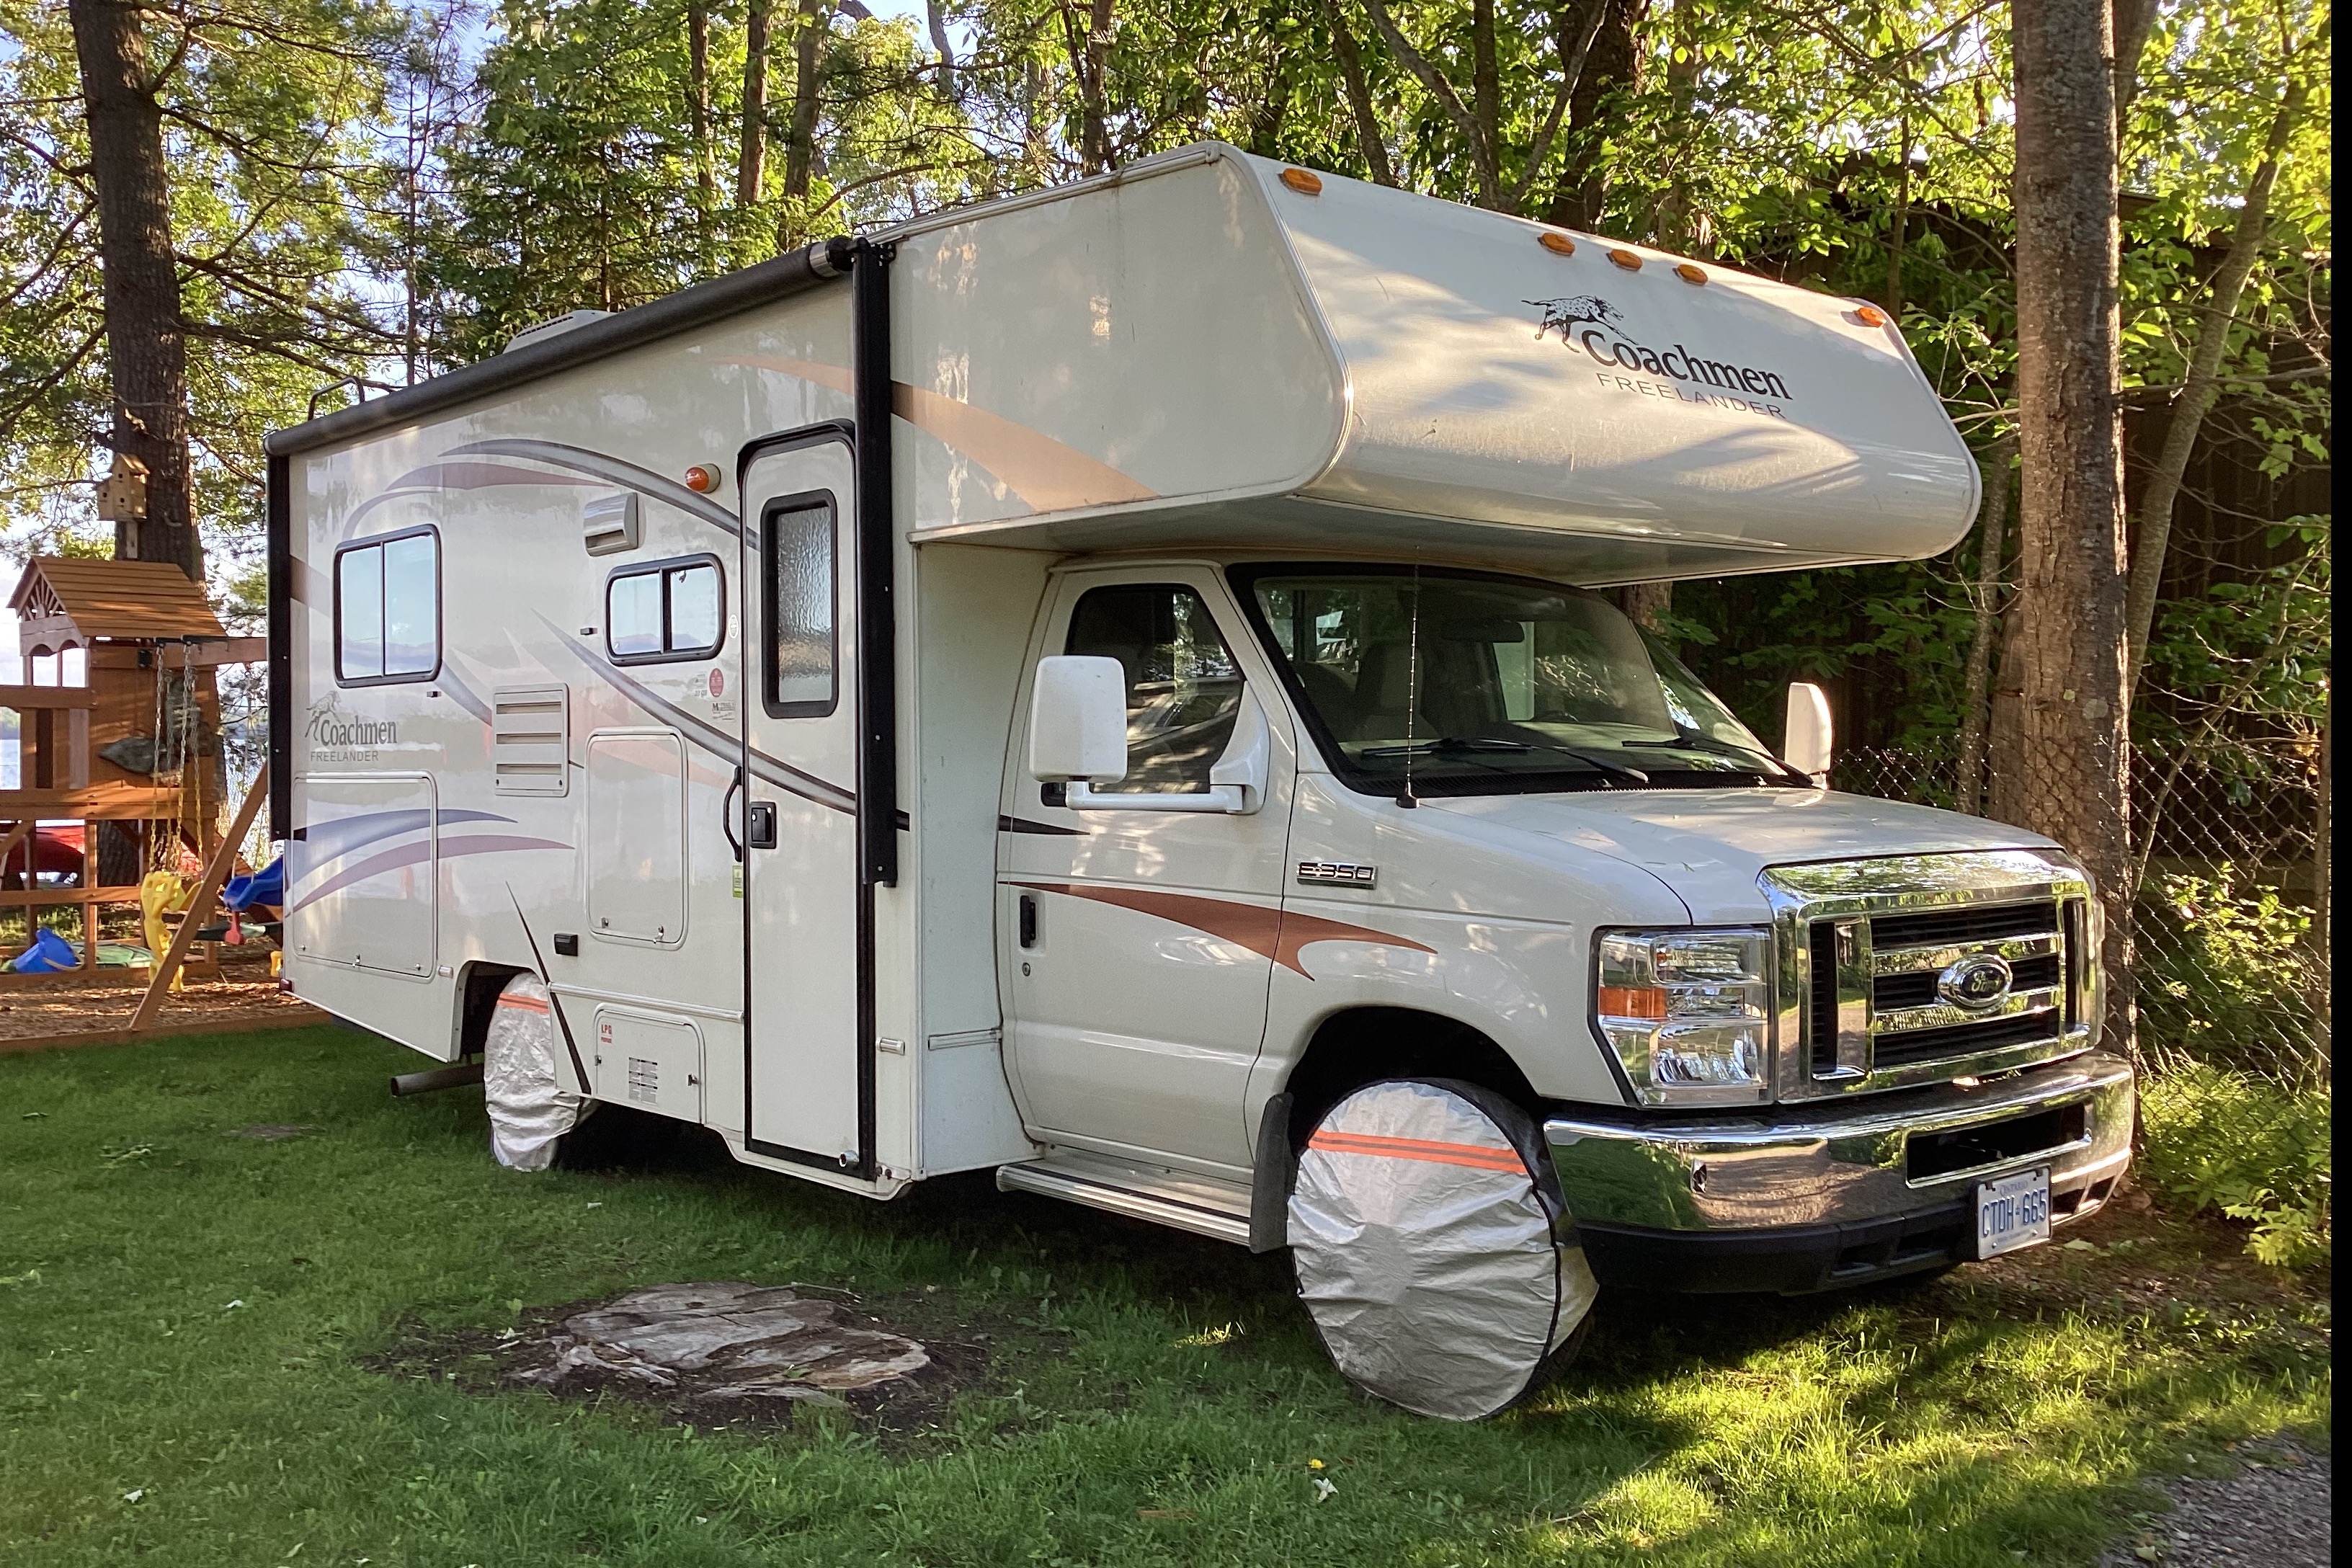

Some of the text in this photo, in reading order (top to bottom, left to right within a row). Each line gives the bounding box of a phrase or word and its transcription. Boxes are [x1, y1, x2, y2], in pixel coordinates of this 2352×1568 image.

[1582, 330, 1793, 400] Coachmen
[1596, 373, 1786, 419] FREELANDER
[320, 715, 397, 746] Coachmen
[310, 750, 378, 762] FREELANDER
[2023, 1188, 2047, 1226] 665
